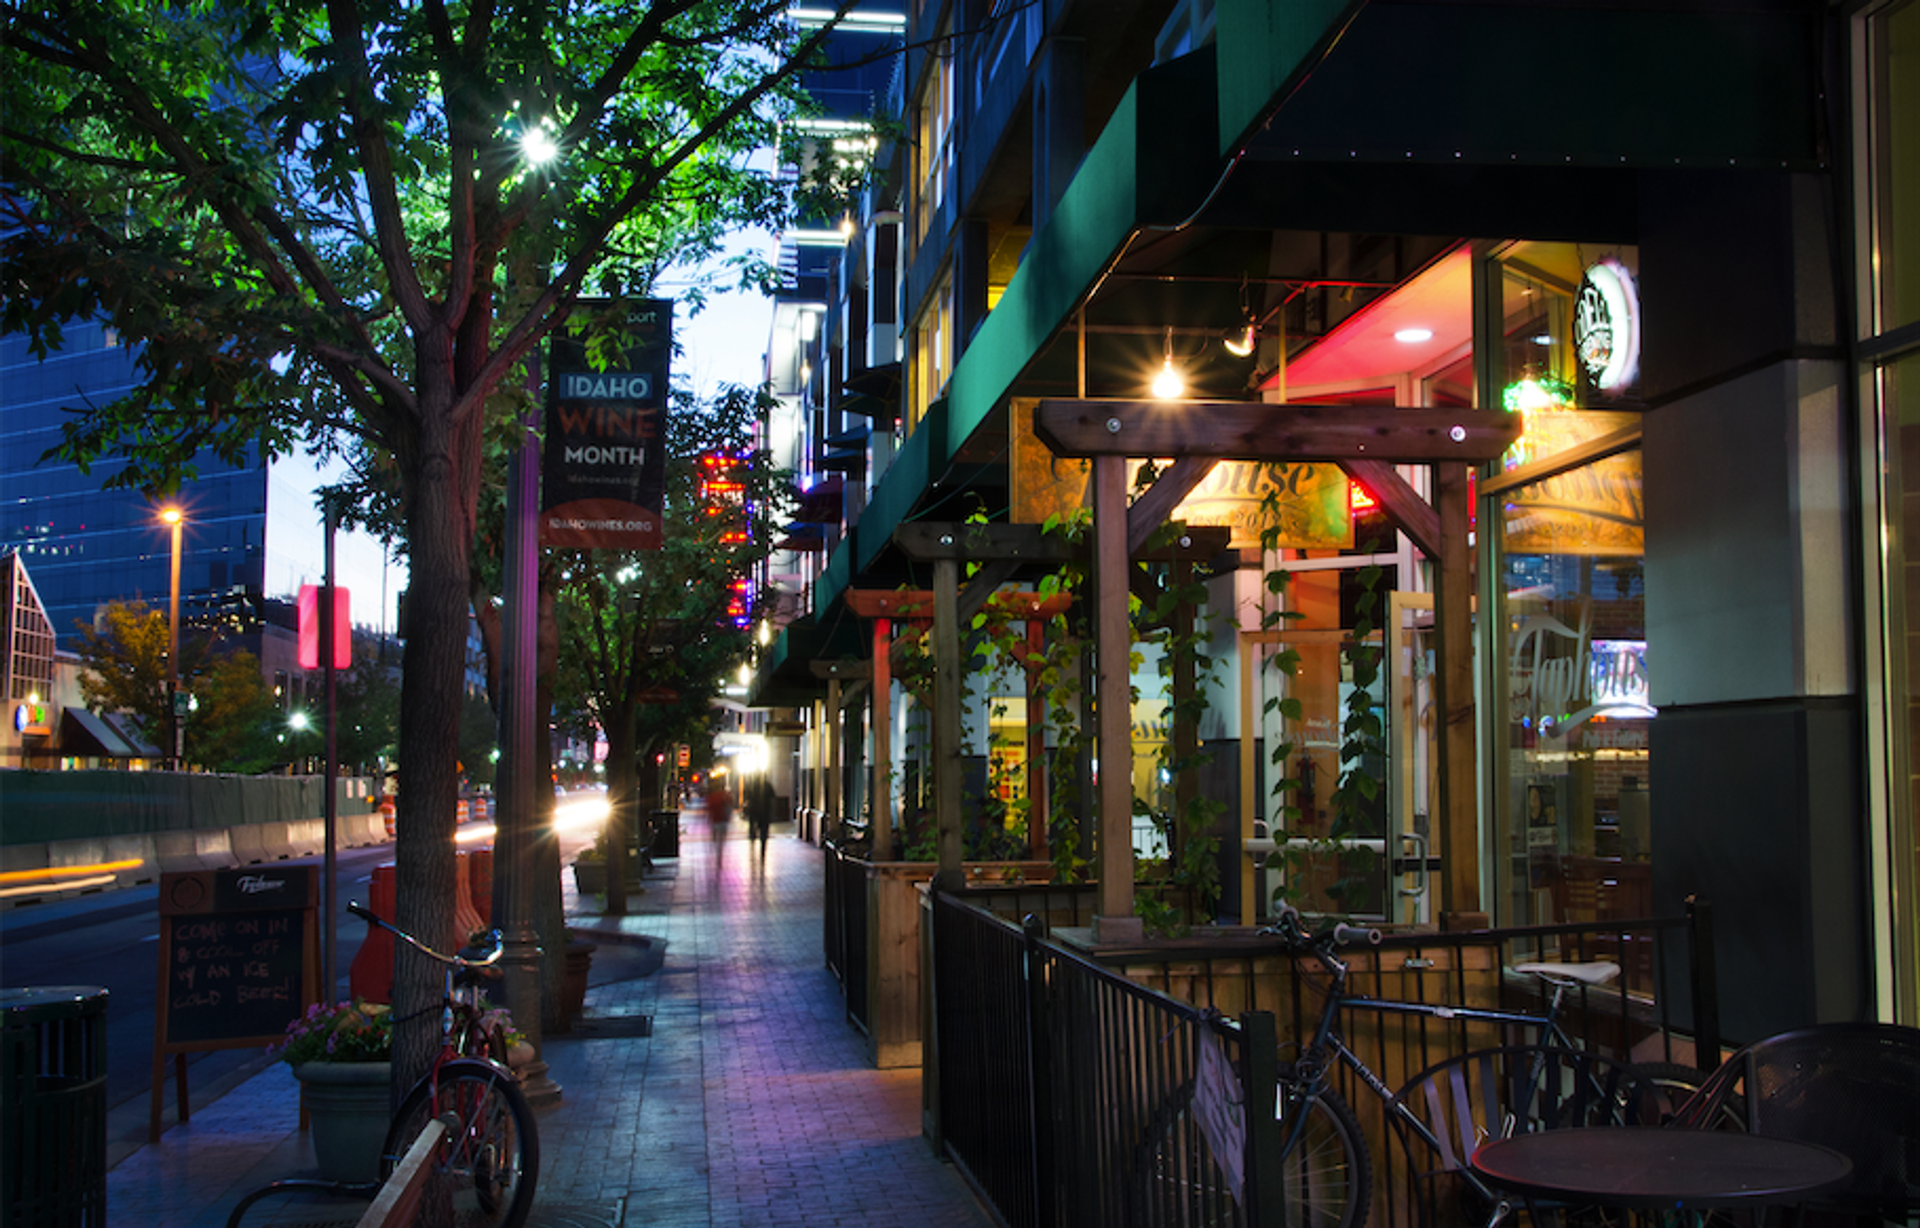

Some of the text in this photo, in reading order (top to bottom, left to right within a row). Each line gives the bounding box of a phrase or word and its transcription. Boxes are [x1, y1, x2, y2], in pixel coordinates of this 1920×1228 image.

[567, 377, 649, 398] IDAHO
[557, 405, 658, 438] WINE
[565, 446, 645, 465] MONTH
[548, 518, 653, 532] IDAHOWINES.ORG
[235, 919, 259, 935] ON
[268, 918, 288, 935] IN
[252, 939, 280, 956] OFF
[207, 963, 231, 979] AN
[243, 961, 269, 978] ICE
[173, 989, 221, 1009] COLD
